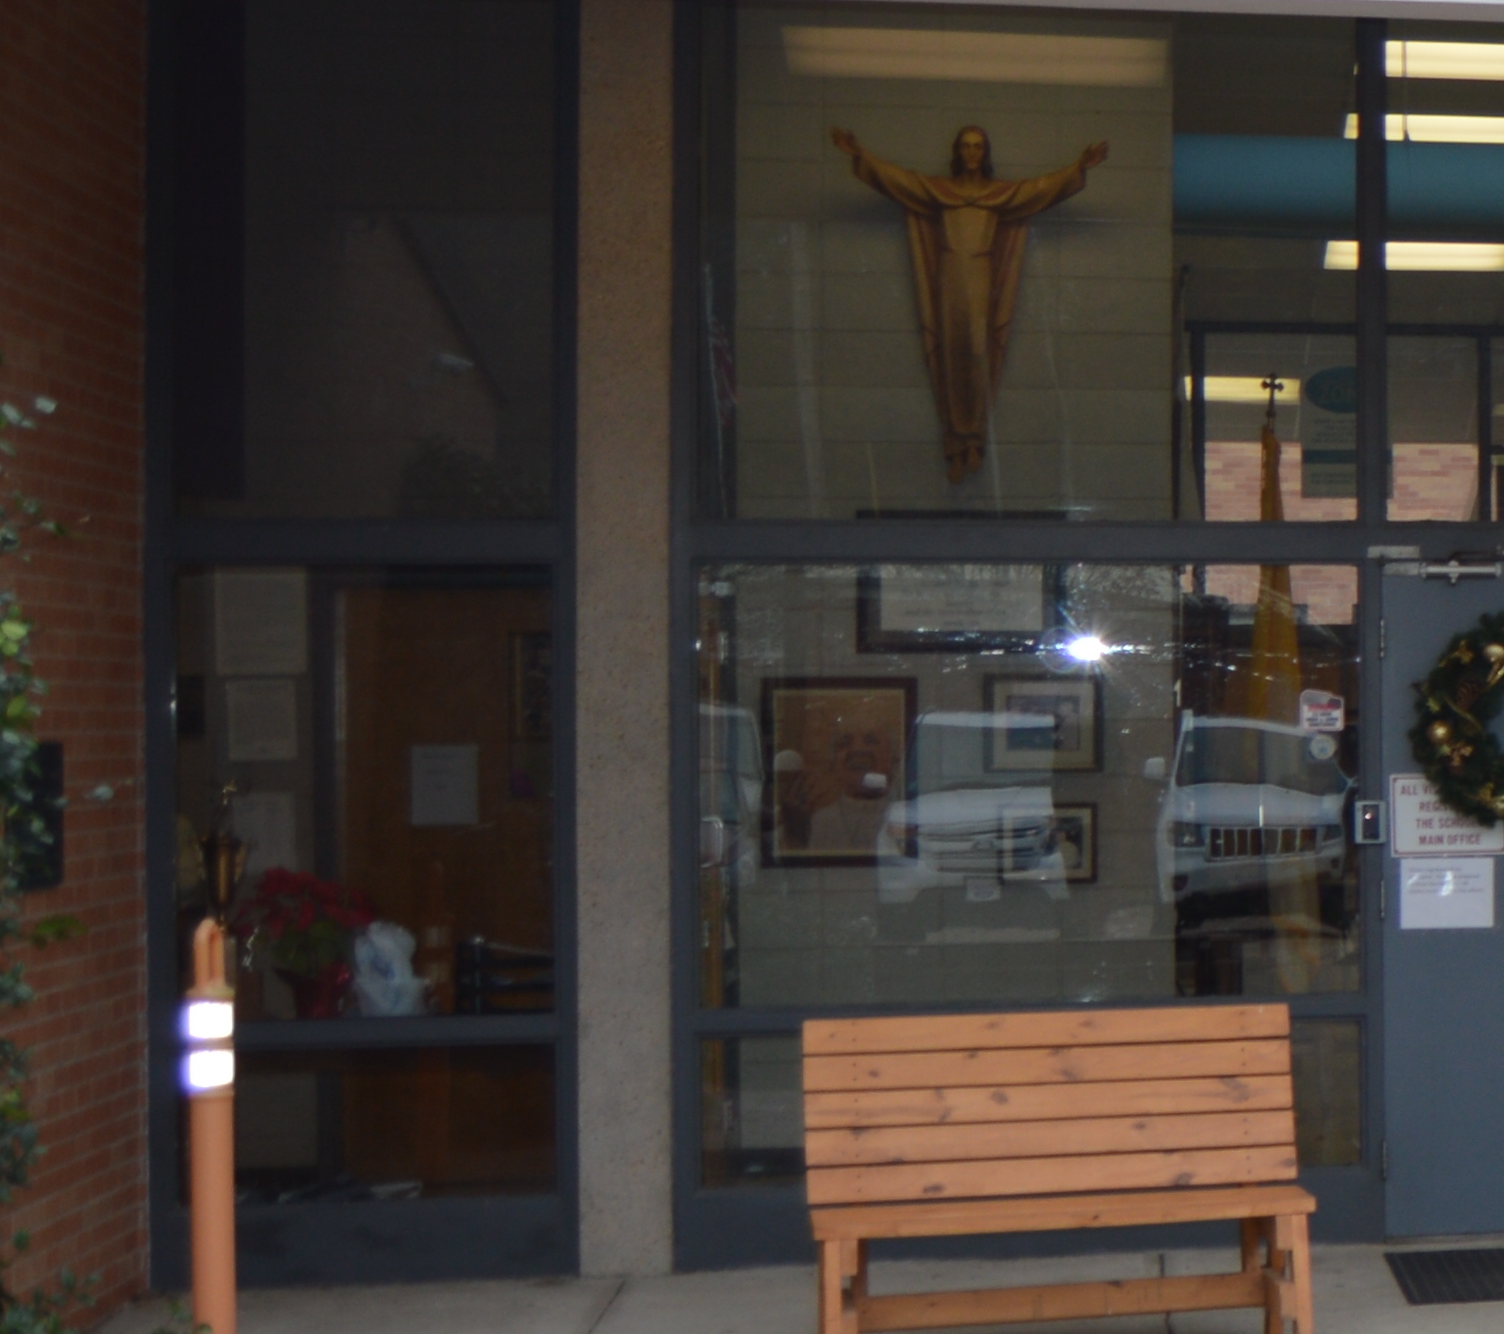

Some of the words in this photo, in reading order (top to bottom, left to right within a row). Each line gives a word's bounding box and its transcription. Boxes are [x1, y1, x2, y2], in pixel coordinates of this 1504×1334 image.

[1400, 785, 1417, 795] ALL
[1416, 818, 1433, 829] THE
[1418, 835, 1444, 845] MAIN
[1447, 834, 1481, 845] OFFICE
